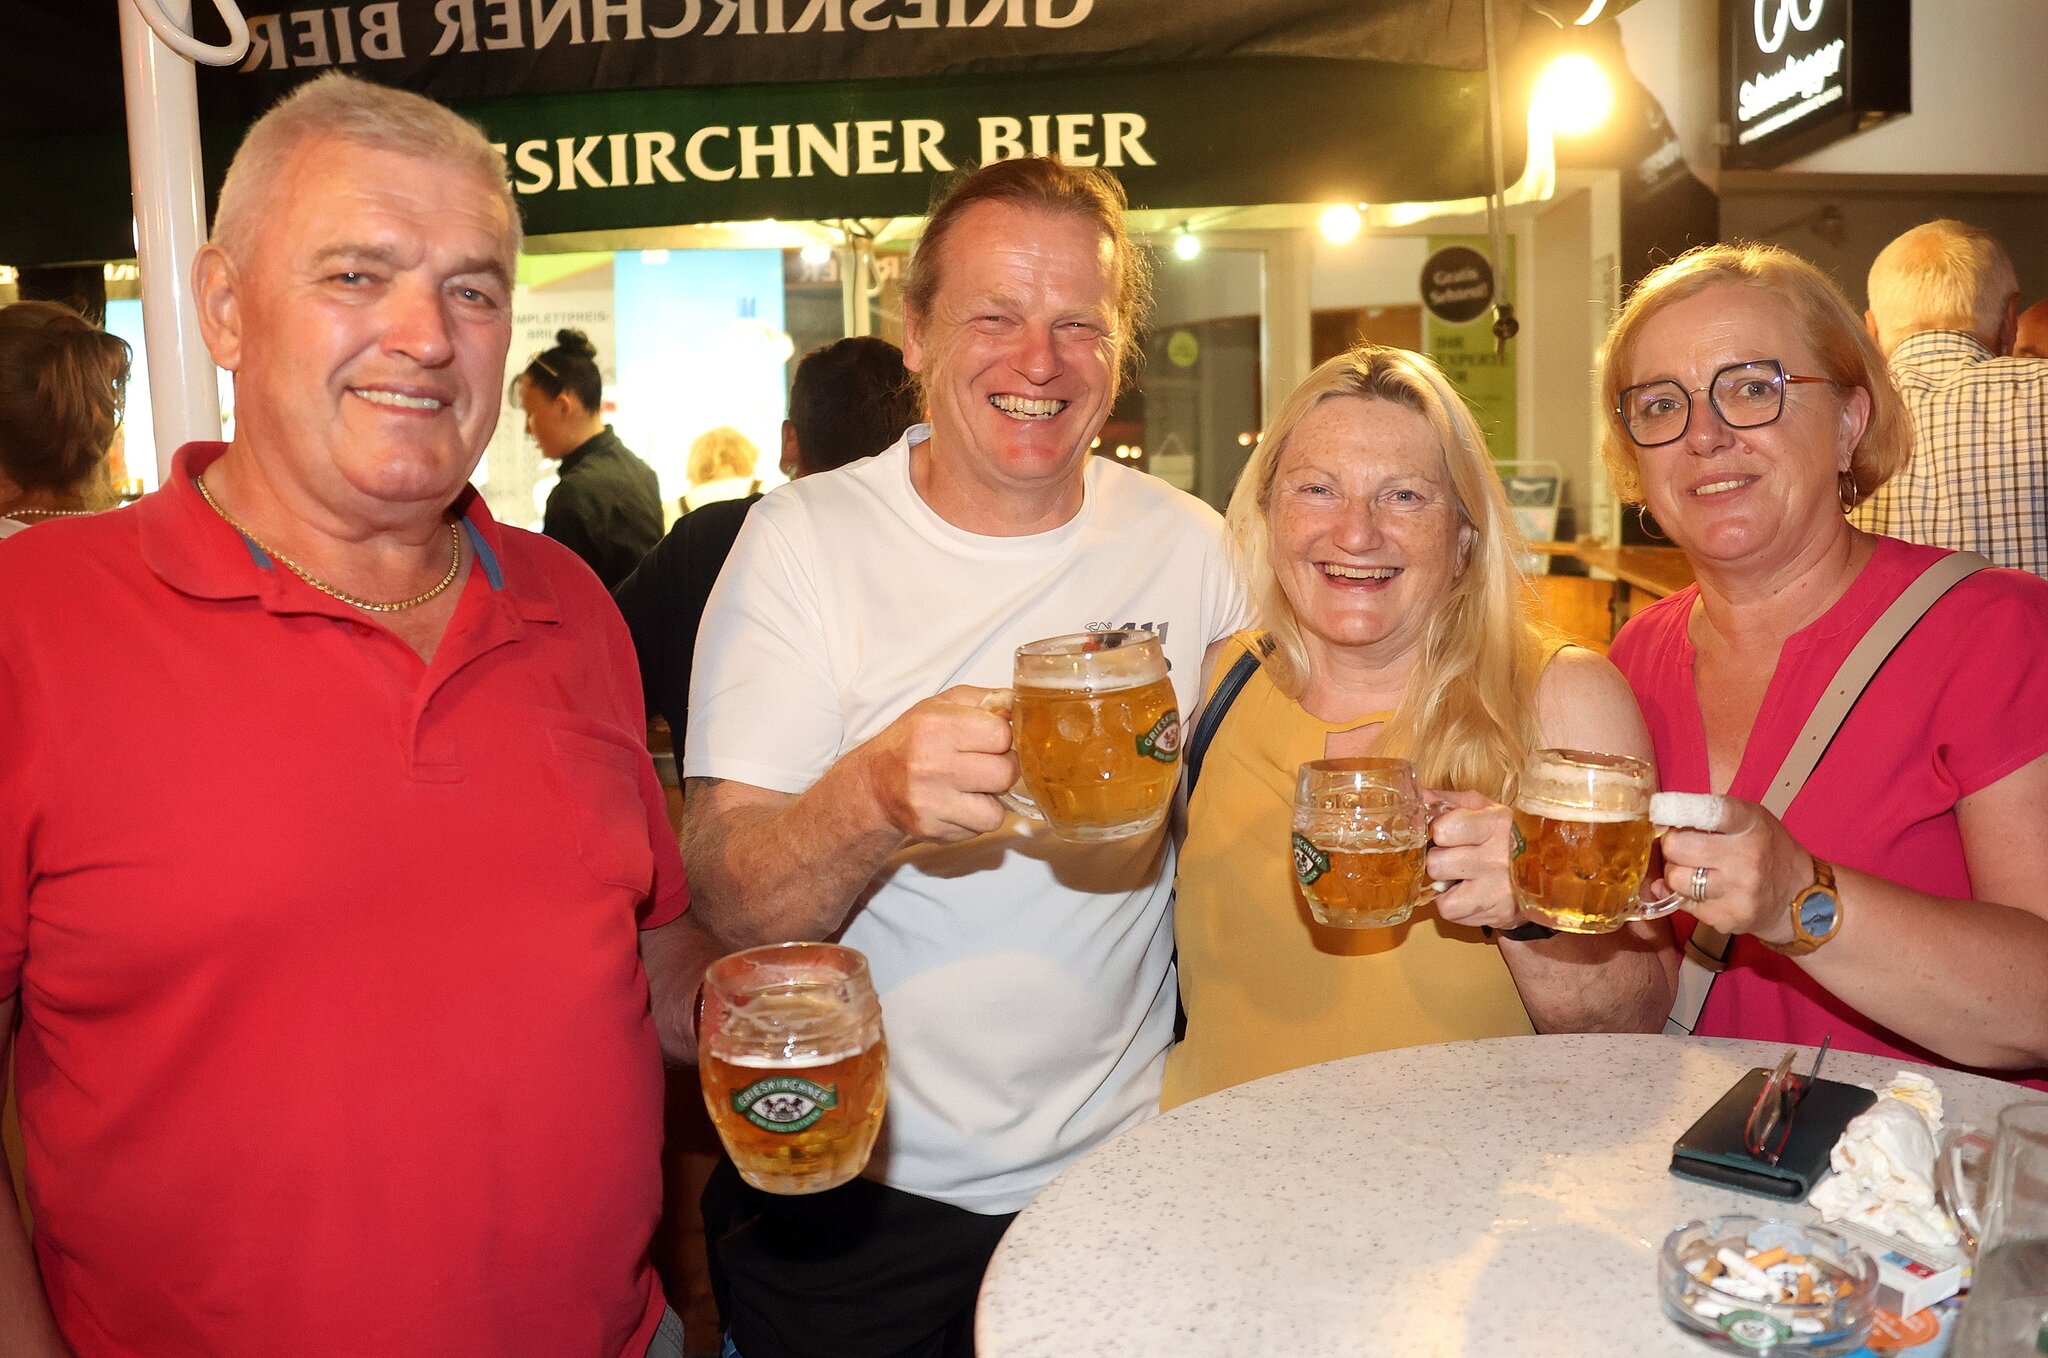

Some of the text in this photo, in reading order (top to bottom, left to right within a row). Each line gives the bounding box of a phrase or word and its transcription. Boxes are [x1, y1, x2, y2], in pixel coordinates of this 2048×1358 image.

[495, 112, 1158, 195] SKIRCHNER BIER
[514, 310, 609, 325] MPLETTPREIS-
